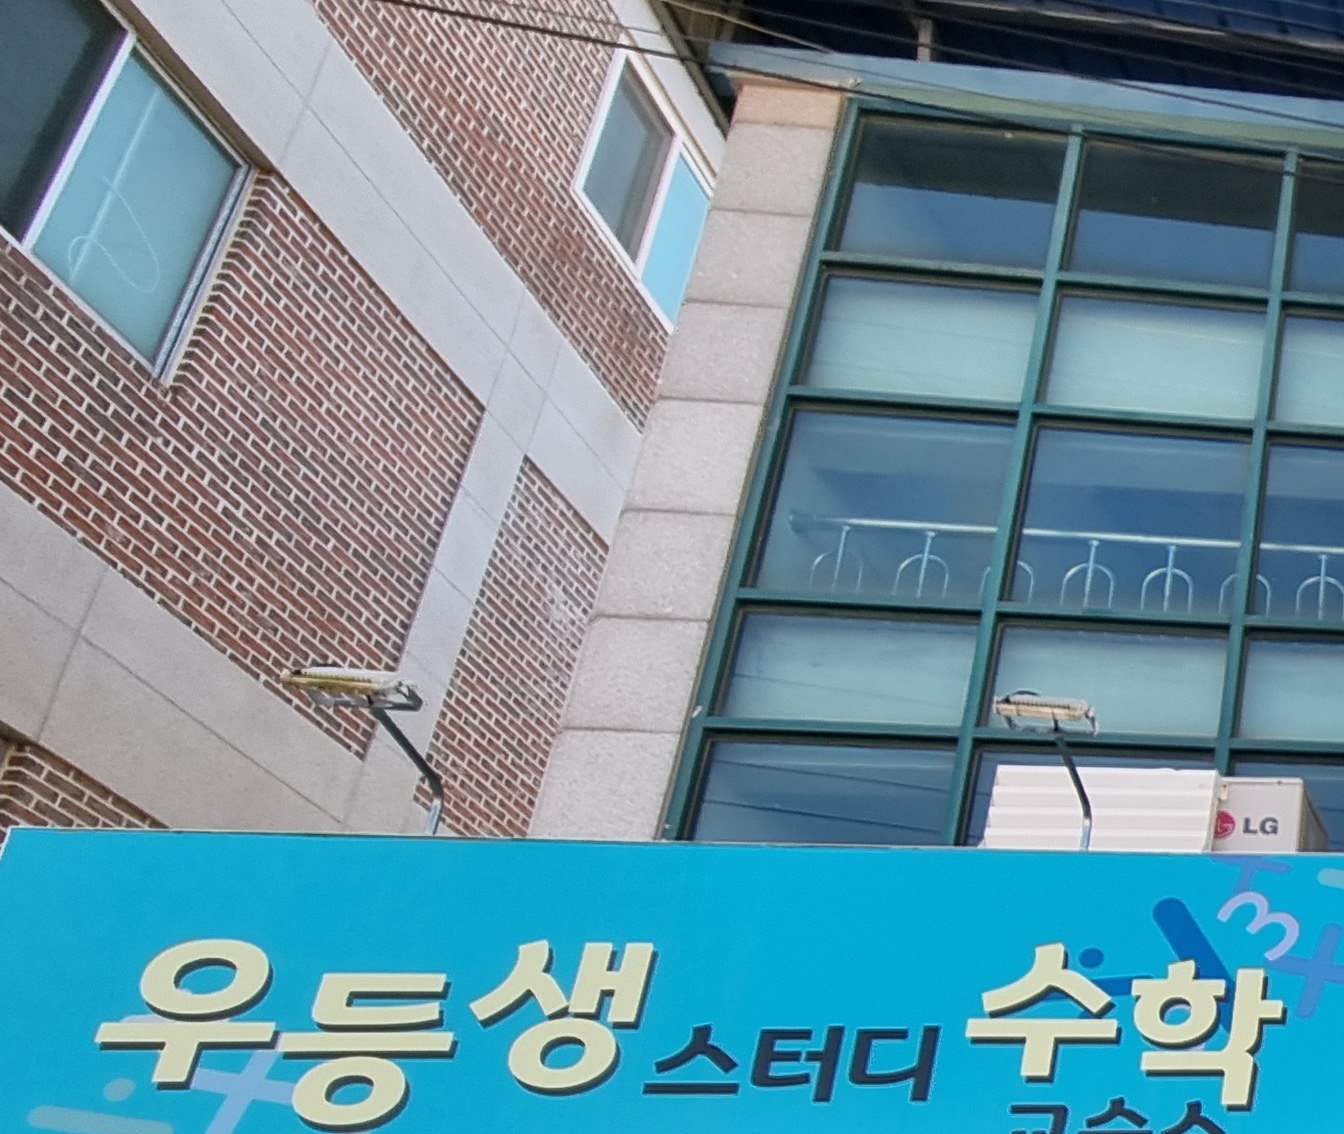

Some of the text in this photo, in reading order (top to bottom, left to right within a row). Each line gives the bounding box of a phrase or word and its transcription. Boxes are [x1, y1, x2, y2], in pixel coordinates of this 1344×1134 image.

[1243, 817, 1278, 834] LG
[95, 939, 1283, 1131] 우등생 스터디 수학
